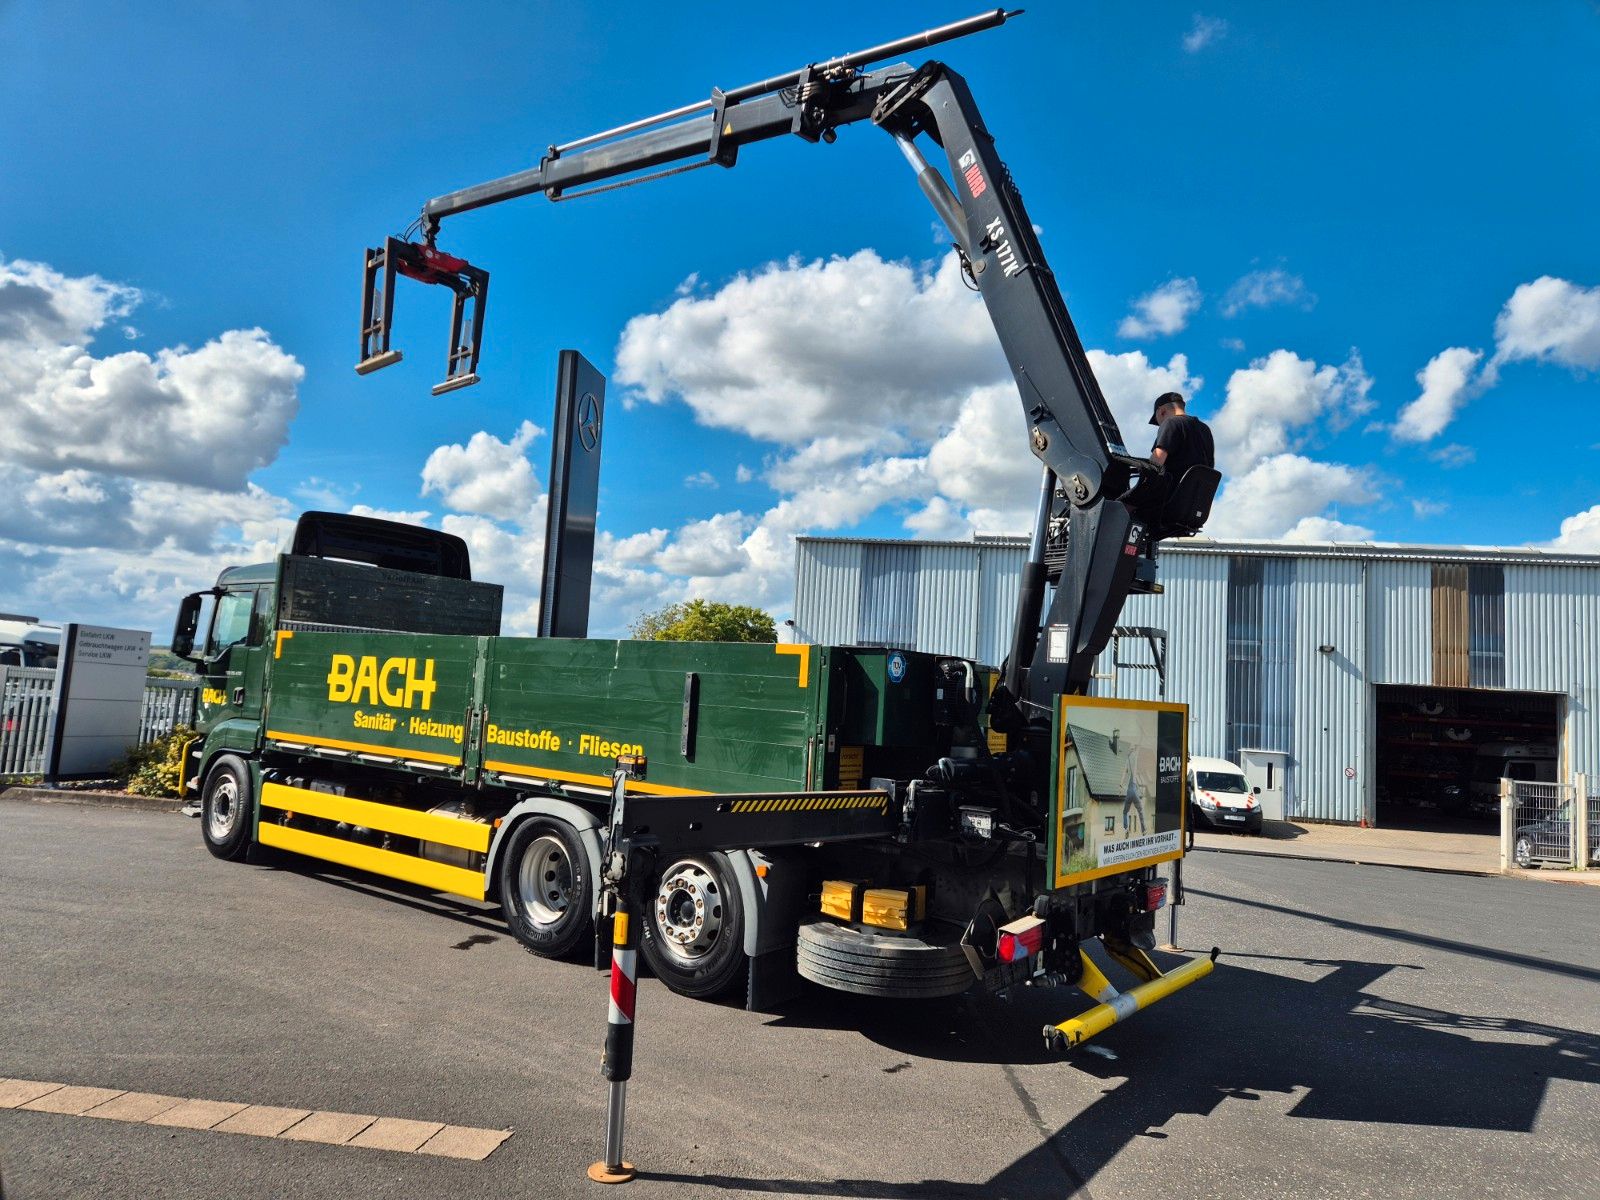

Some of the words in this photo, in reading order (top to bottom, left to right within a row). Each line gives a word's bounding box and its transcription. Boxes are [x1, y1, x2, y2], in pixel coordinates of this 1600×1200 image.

[986, 216, 1004, 241] XS
[996, 240, 1020, 278] 177K
[79, 641, 123, 651] Gebrauchtwagen
[327, 654, 436, 710] BACH
[353, 710, 396, 732] Sanitär
[409, 716, 464, 744] Heizung
[487, 724, 561, 752] Baustoffe
[579, 734, 644, 760] Fliesen
[1159, 757, 1181, 772] BACH
[1103, 844, 1115, 854] WAS
[1115, 841, 1130, 852] AUCH
[1130, 838, 1145, 849] IMMER
[1146, 837, 1154, 846] IHR
